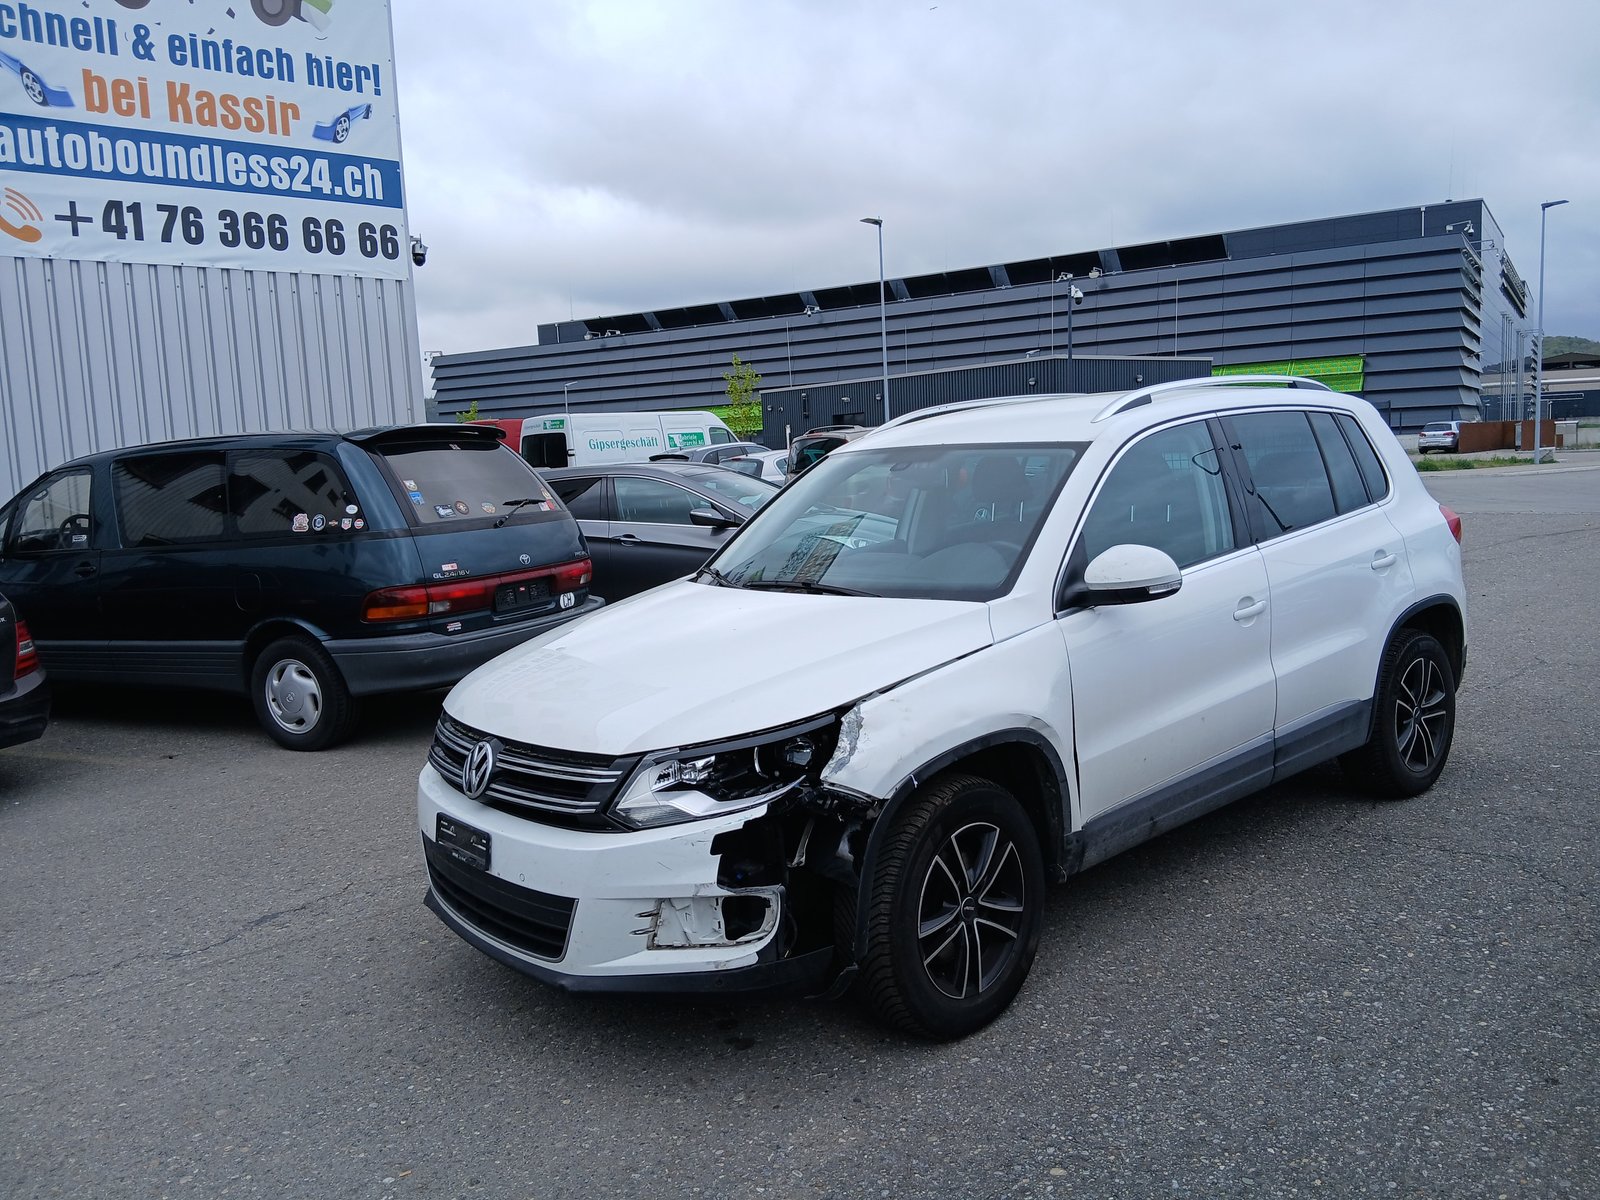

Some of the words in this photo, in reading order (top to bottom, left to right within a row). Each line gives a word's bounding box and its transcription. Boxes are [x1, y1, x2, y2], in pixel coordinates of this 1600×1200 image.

[133, 24, 155, 62] &
[168, 34, 294, 82] einfach
[306, 53, 381, 96] hier!
[82, 68, 151, 119] bei
[166, 81, 300, 136] Kassir
[0, 124, 383, 200] autoboundless24.ch
[157, 204, 204, 245] 76
[218, 209, 289, 251] 366
[302, 217, 345, 255] 66
[358, 222, 399, 260] 66
[588, 437, 659, 452] Gipsergeschäft
[562, 593, 574, 607] CH
